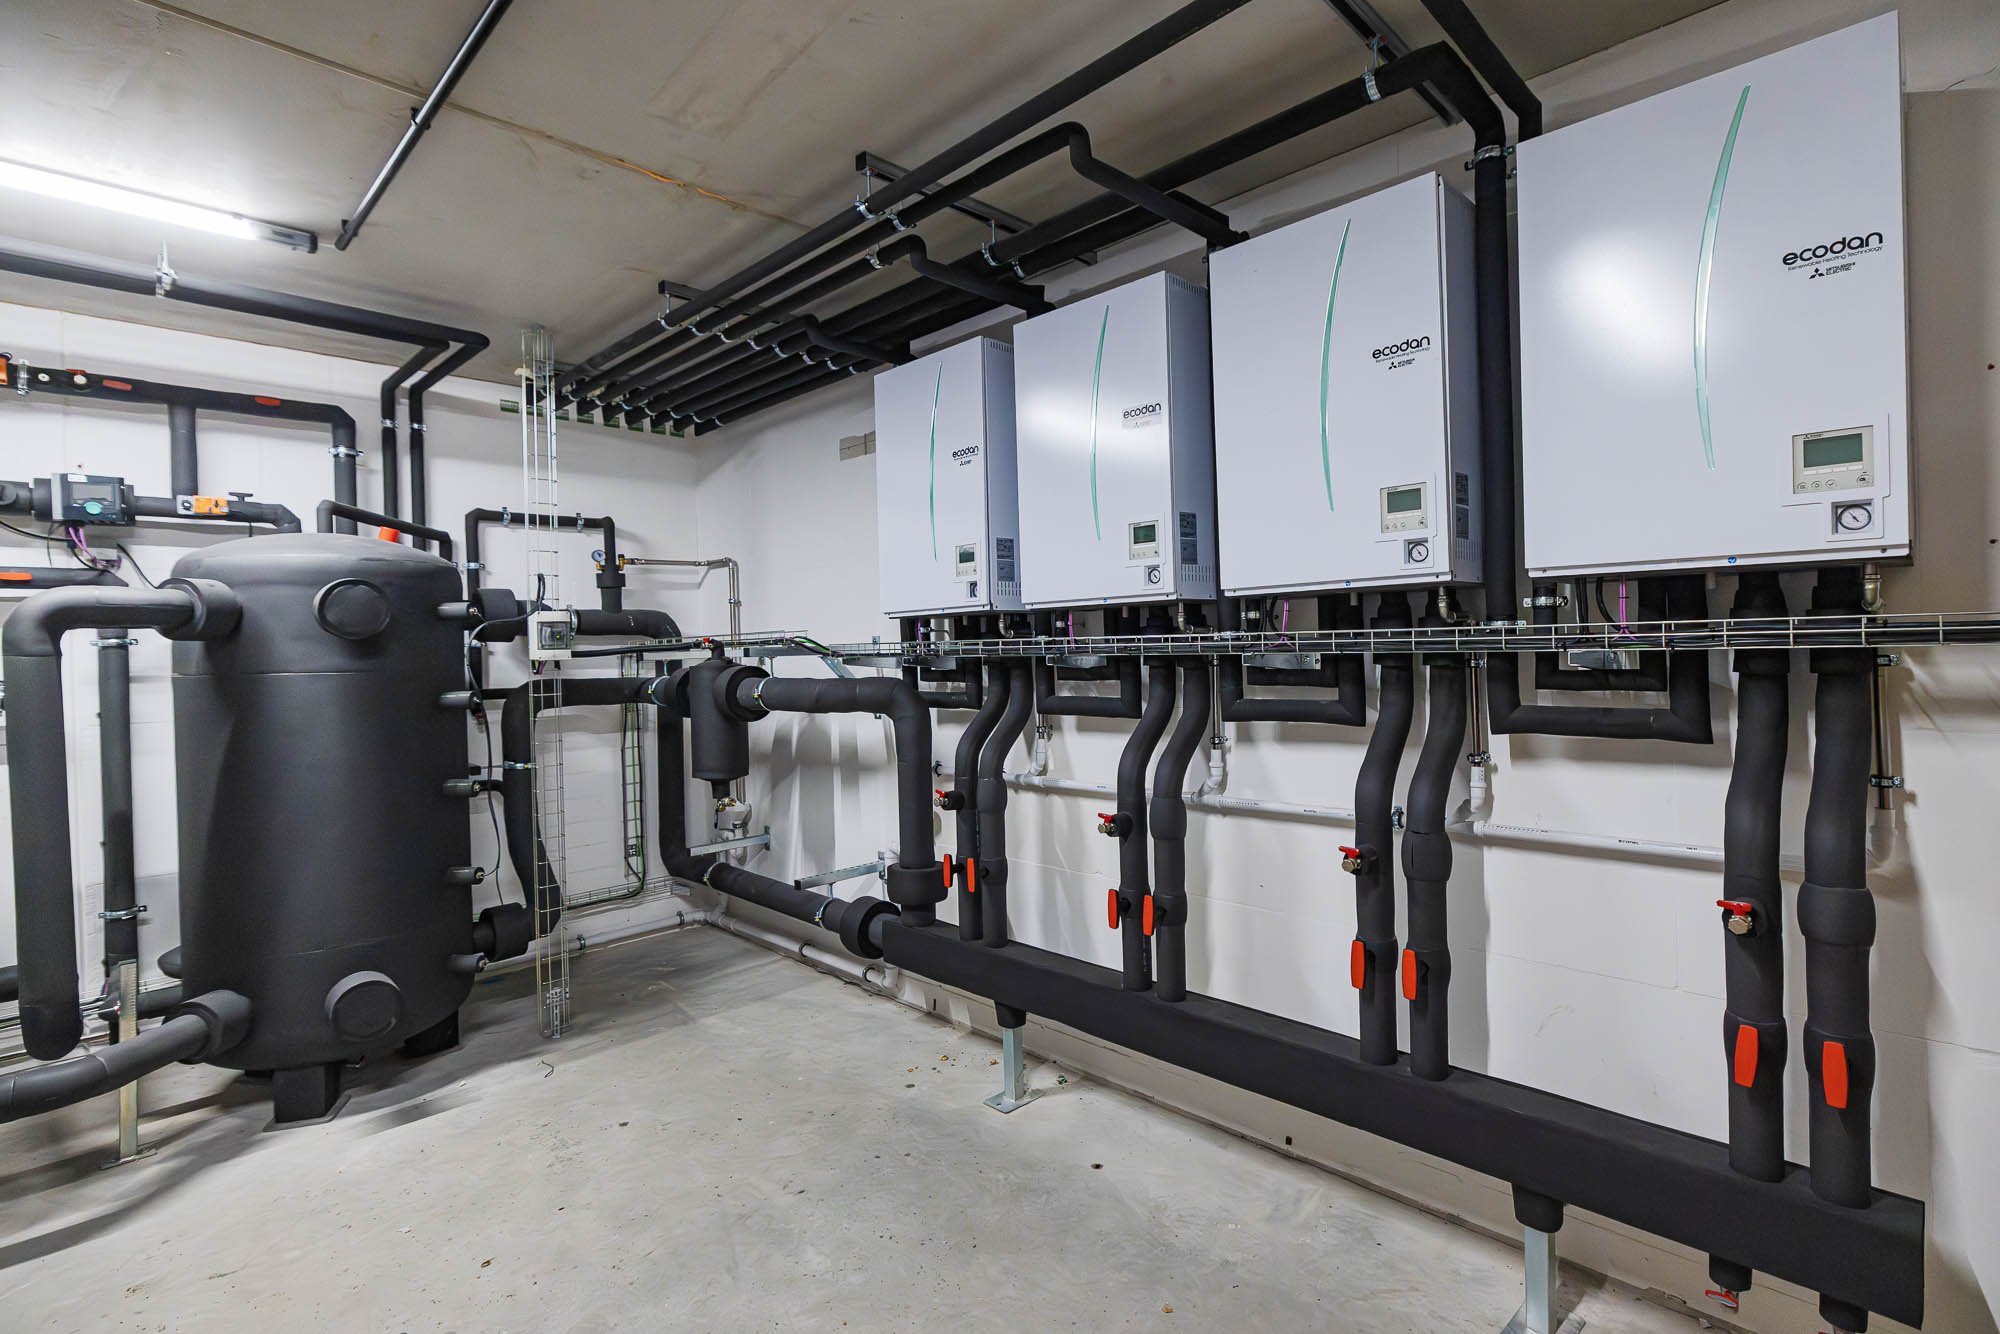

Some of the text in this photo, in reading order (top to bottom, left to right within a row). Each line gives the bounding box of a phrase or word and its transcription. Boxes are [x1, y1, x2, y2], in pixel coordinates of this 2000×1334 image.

[1782, 232, 1883, 265] ecodan
[1372, 336, 1430, 359] ecodan
[1123, 402, 1161, 419] ecodan
[952, 445, 979, 458] ecodan
